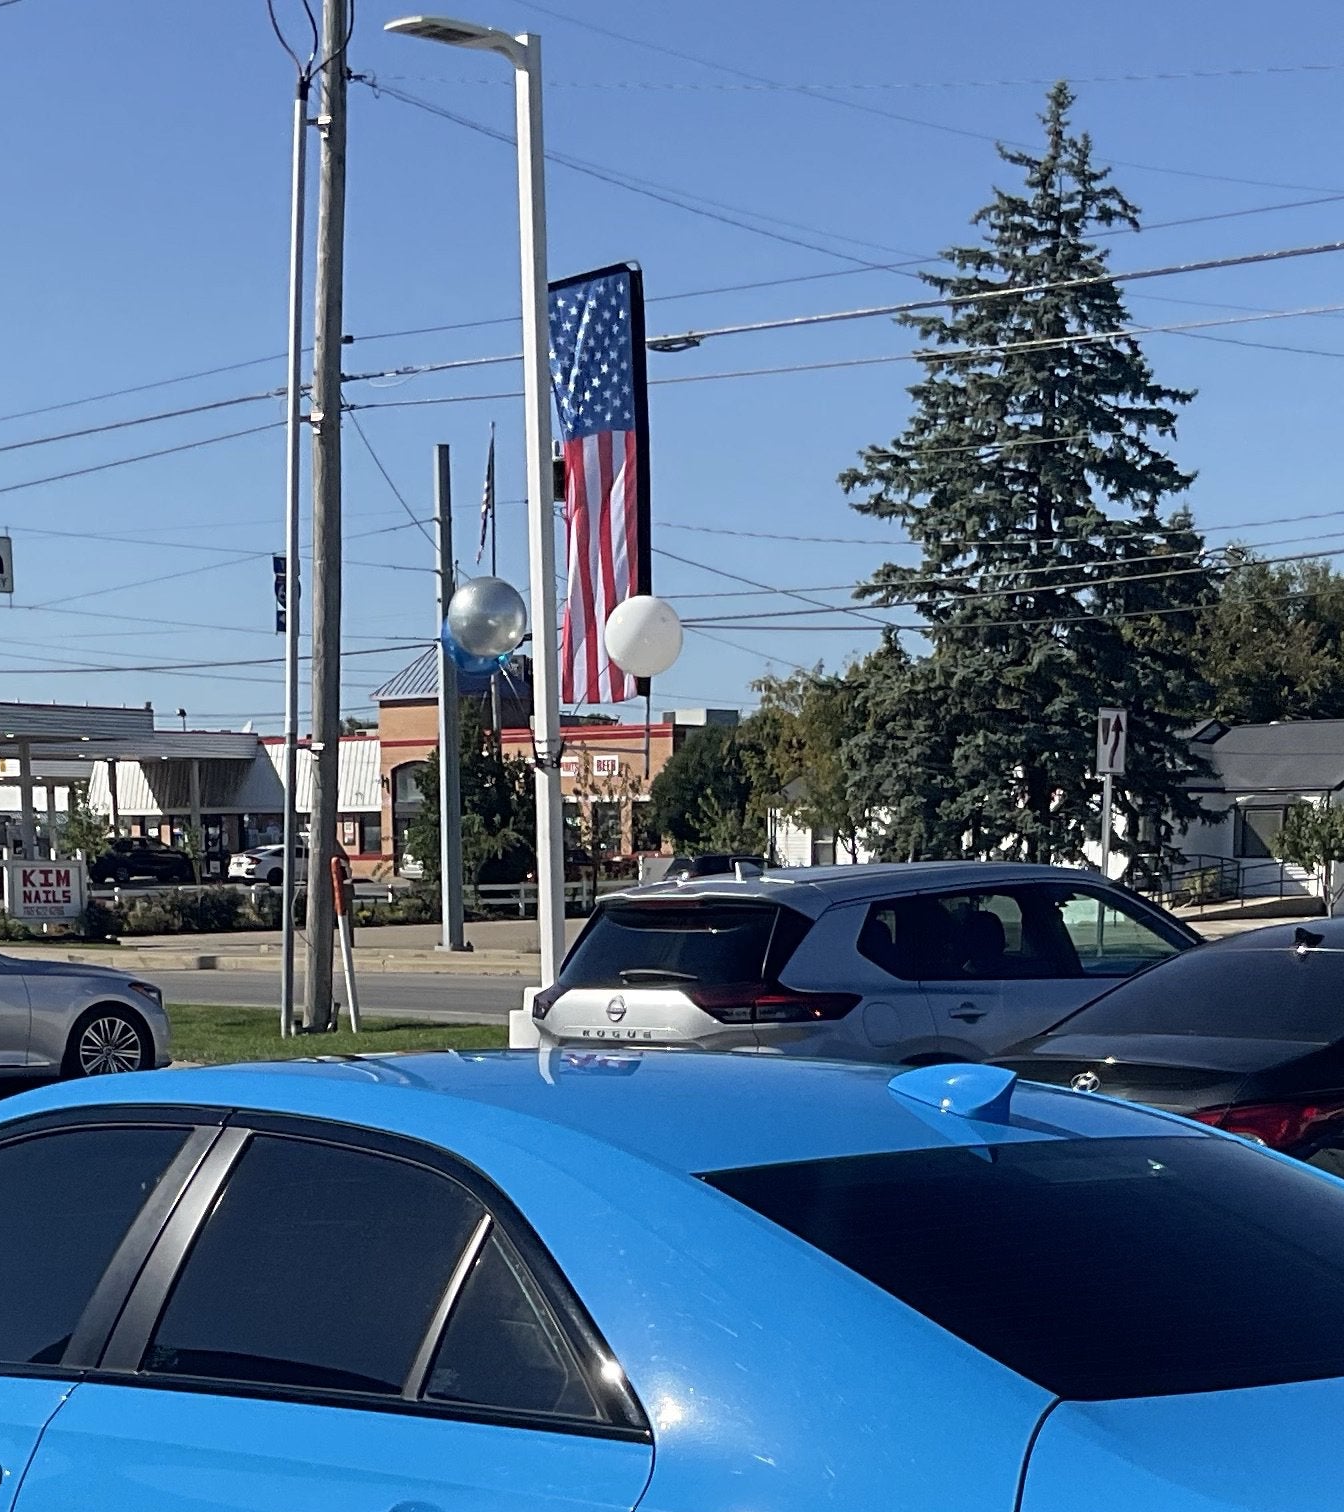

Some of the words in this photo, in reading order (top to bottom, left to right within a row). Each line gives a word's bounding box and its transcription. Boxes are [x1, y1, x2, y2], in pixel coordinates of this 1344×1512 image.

[596, 759, 616, 772] BEER
[22, 869, 71, 888] KIM
[23, 889, 72, 904] NAILS
[582, 1029, 652, 1039] ROGUE
